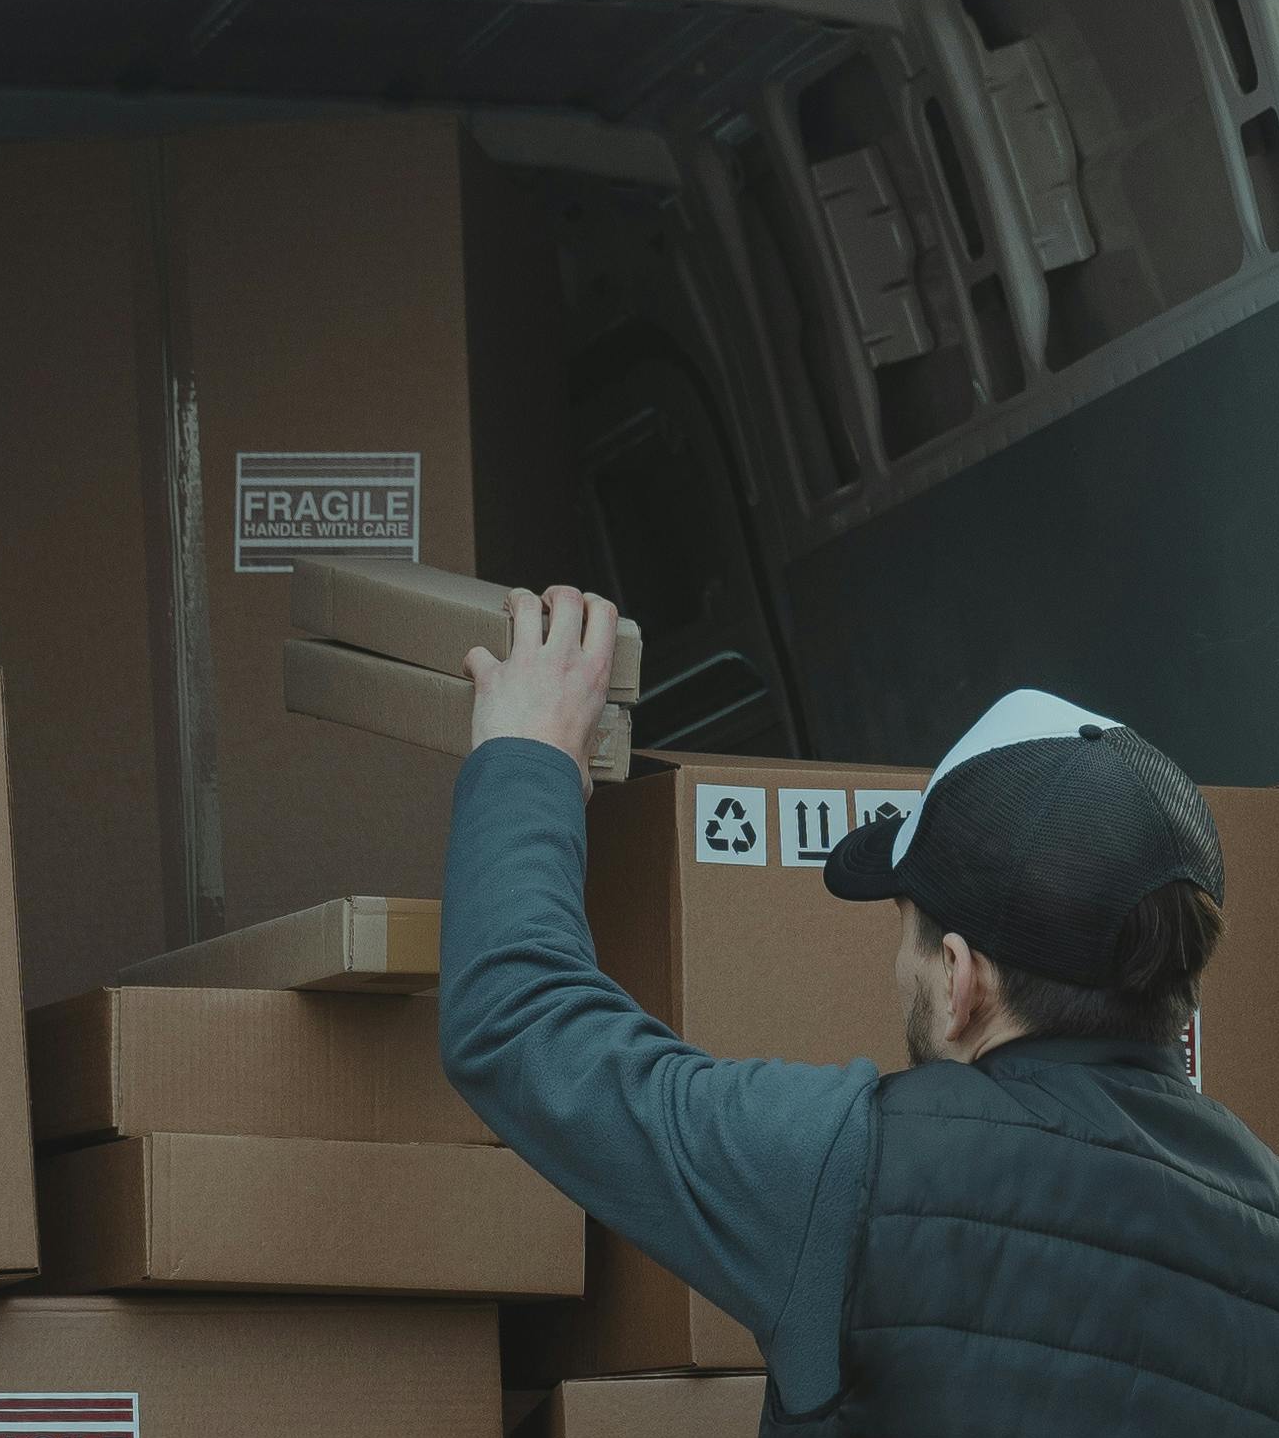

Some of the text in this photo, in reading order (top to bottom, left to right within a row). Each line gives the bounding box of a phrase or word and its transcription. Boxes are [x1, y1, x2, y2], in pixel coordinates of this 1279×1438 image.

[244, 491, 409, 522] FRAGILE
[244, 522, 409, 537] HANDLE WITH CARE
